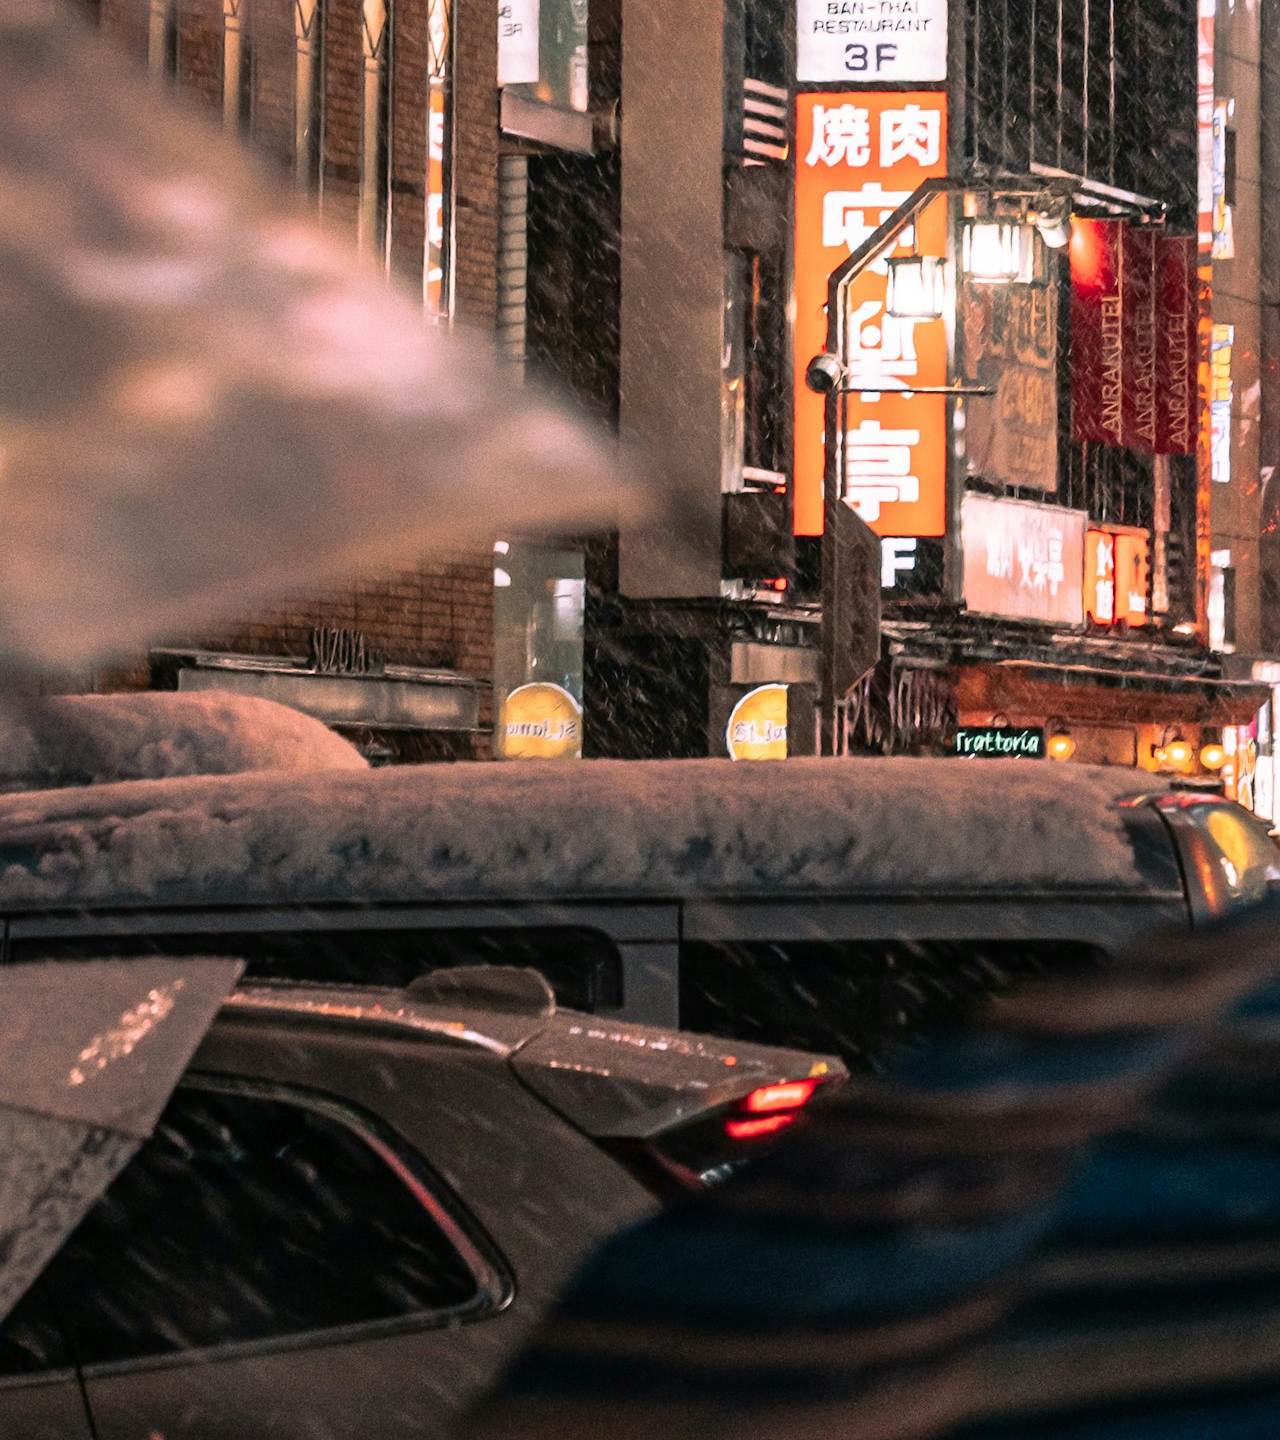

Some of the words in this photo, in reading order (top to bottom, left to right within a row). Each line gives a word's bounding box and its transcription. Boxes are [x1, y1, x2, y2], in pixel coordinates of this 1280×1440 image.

[827, 0, 920, 15] BAN-THAI
[813, 18, 933, 34] RESTAURANT
[845, 43, 898, 71] 3F
[805, 104, 941, 168] 焼肉
[1101, 295, 1121, 435] ANRAKUTEI
[955, 729, 1041, 754] Trattoria
